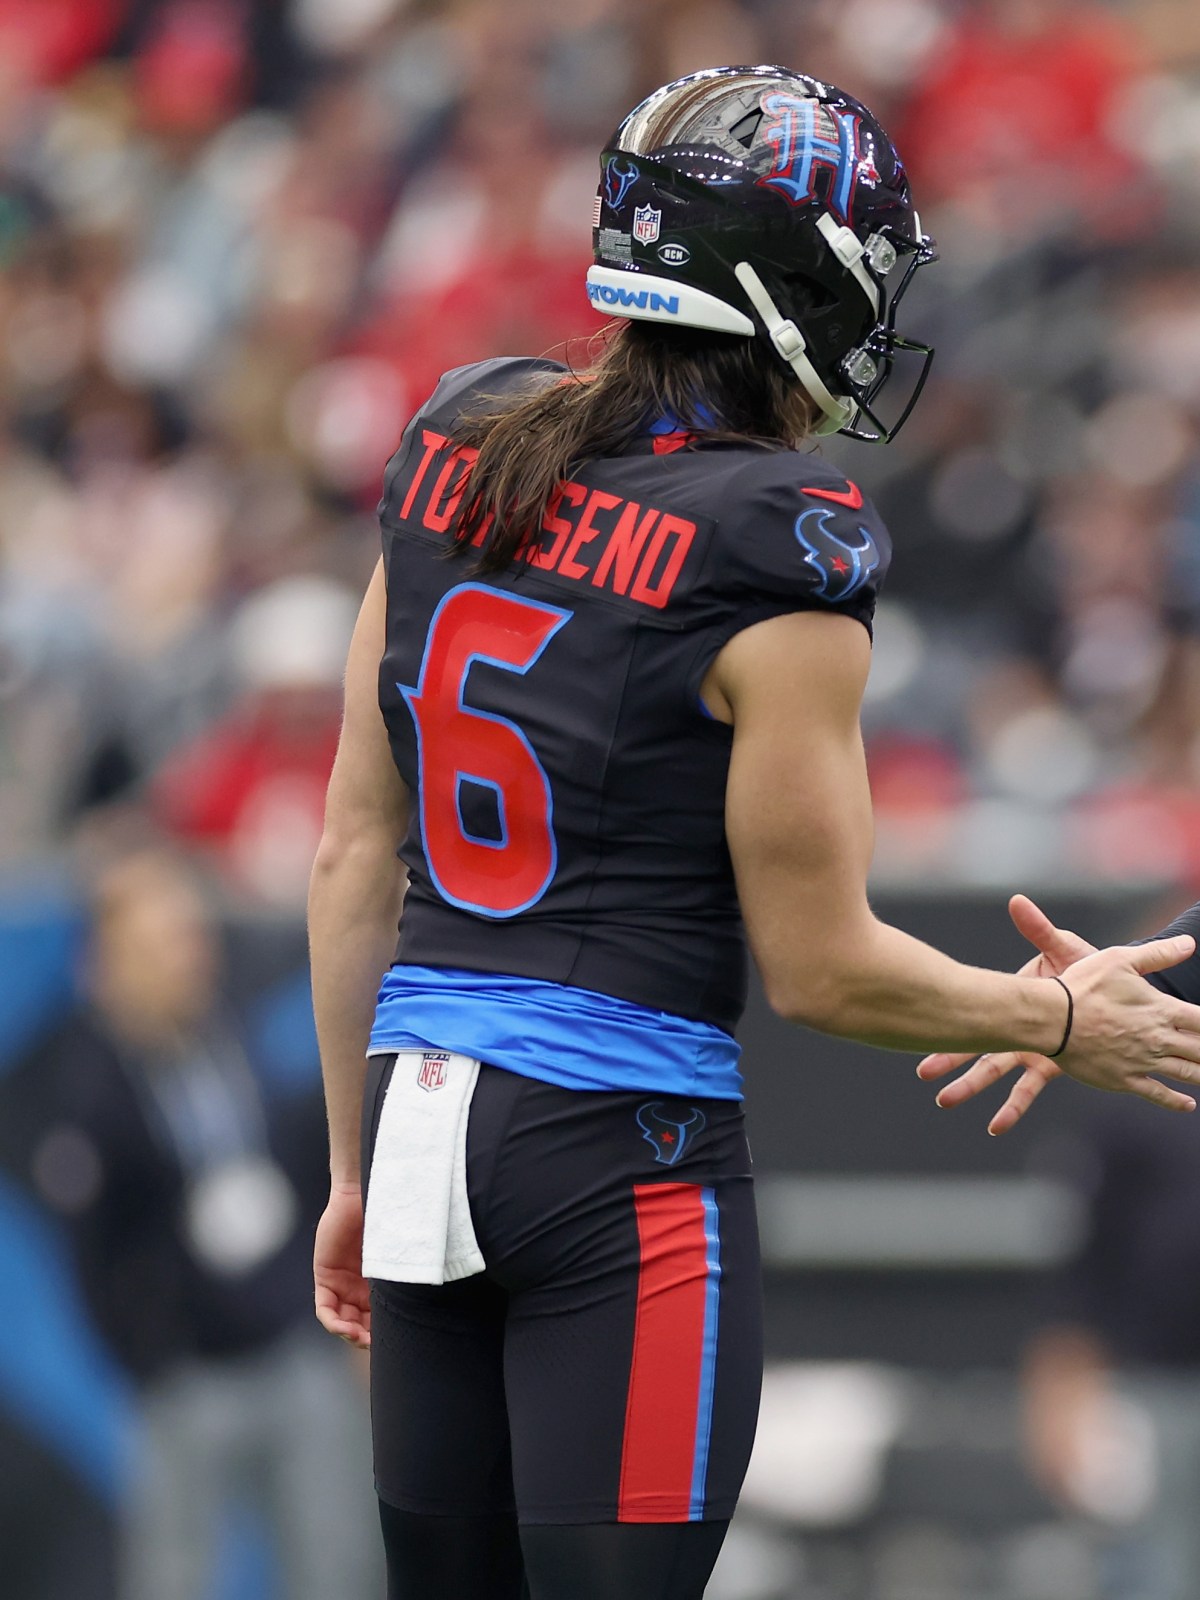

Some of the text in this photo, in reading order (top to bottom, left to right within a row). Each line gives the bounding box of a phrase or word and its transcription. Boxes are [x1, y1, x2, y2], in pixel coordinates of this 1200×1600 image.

[636, 221, 656, 238] NFL
[399, 429, 697, 609] TOSEND
[396, 581, 574, 919] 6
[420, 1061, 444, 1088] NFL
